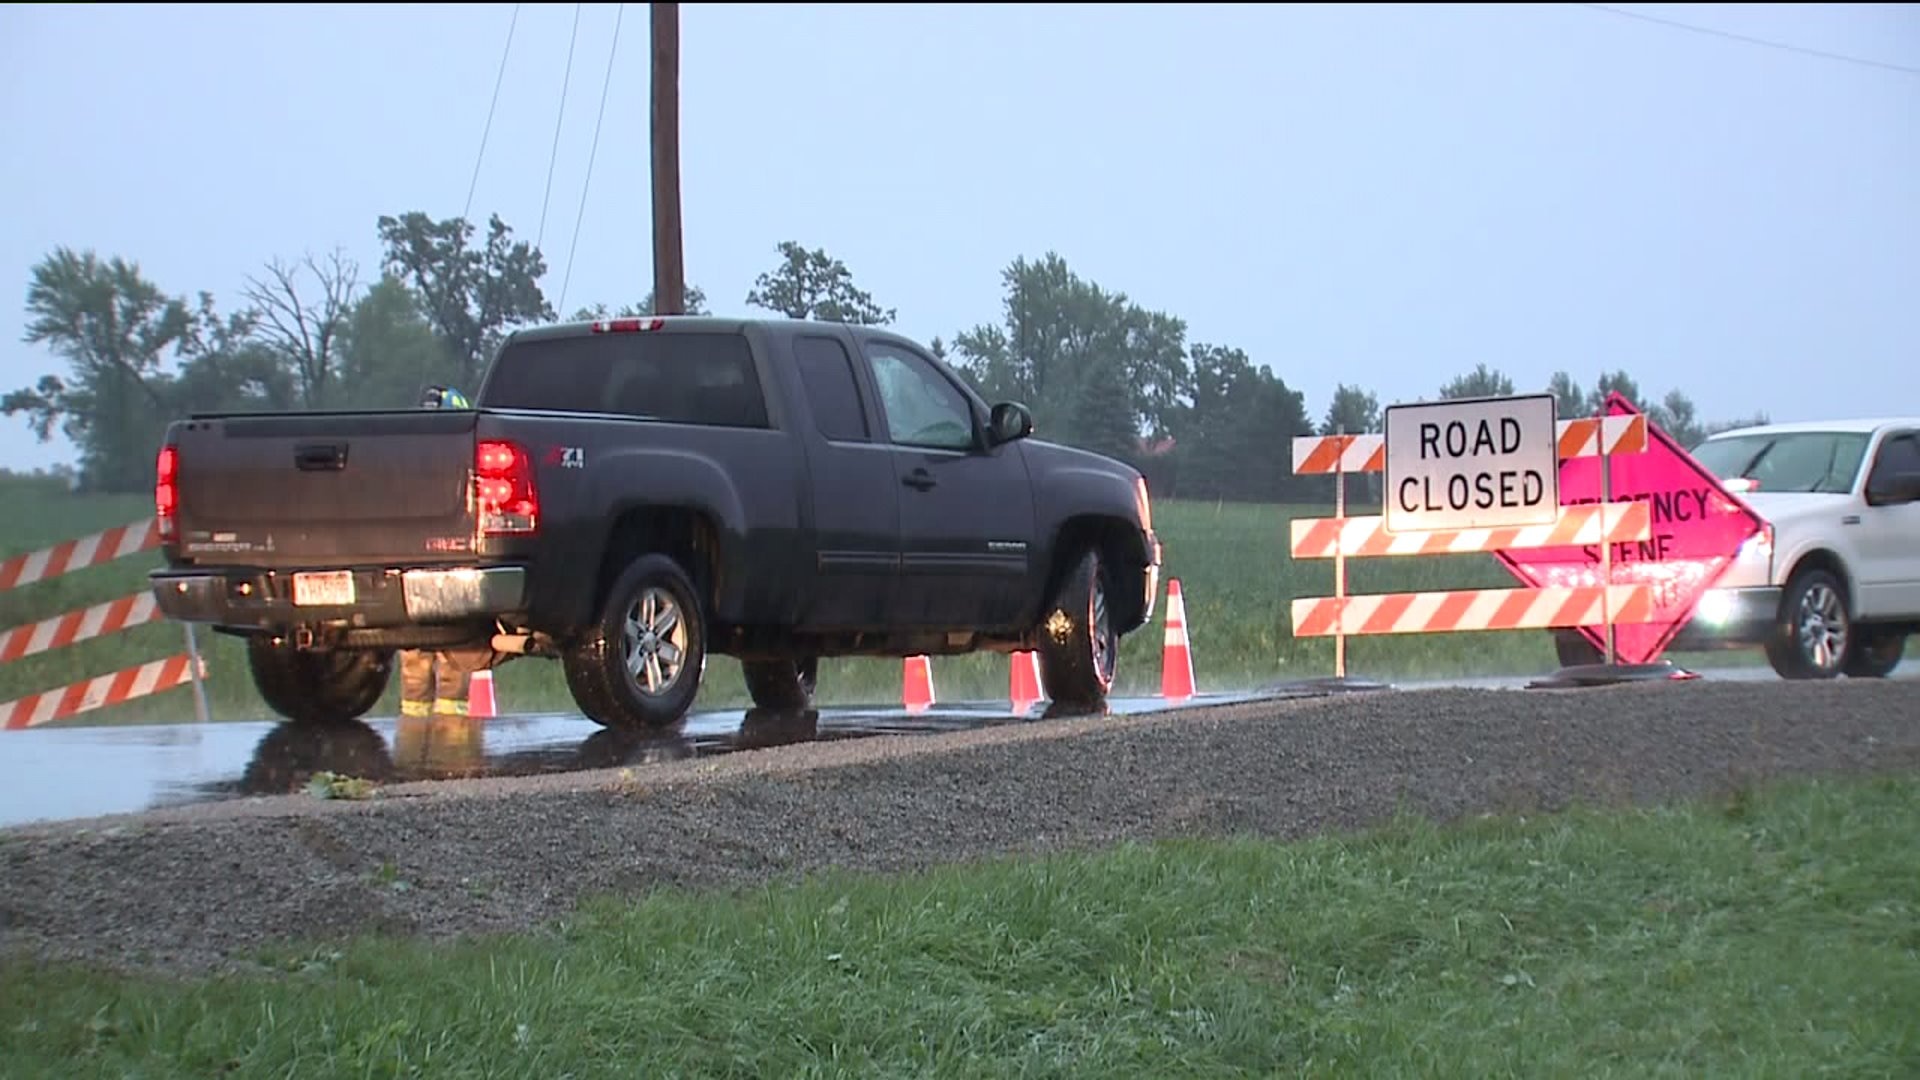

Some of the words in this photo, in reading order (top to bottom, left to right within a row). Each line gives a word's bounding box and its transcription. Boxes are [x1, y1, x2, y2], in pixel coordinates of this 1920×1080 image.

[1420, 417, 1521, 460] ROAD
[1399, 470, 1544, 513] CLOSED
[1583, 534, 1674, 569] SENE
